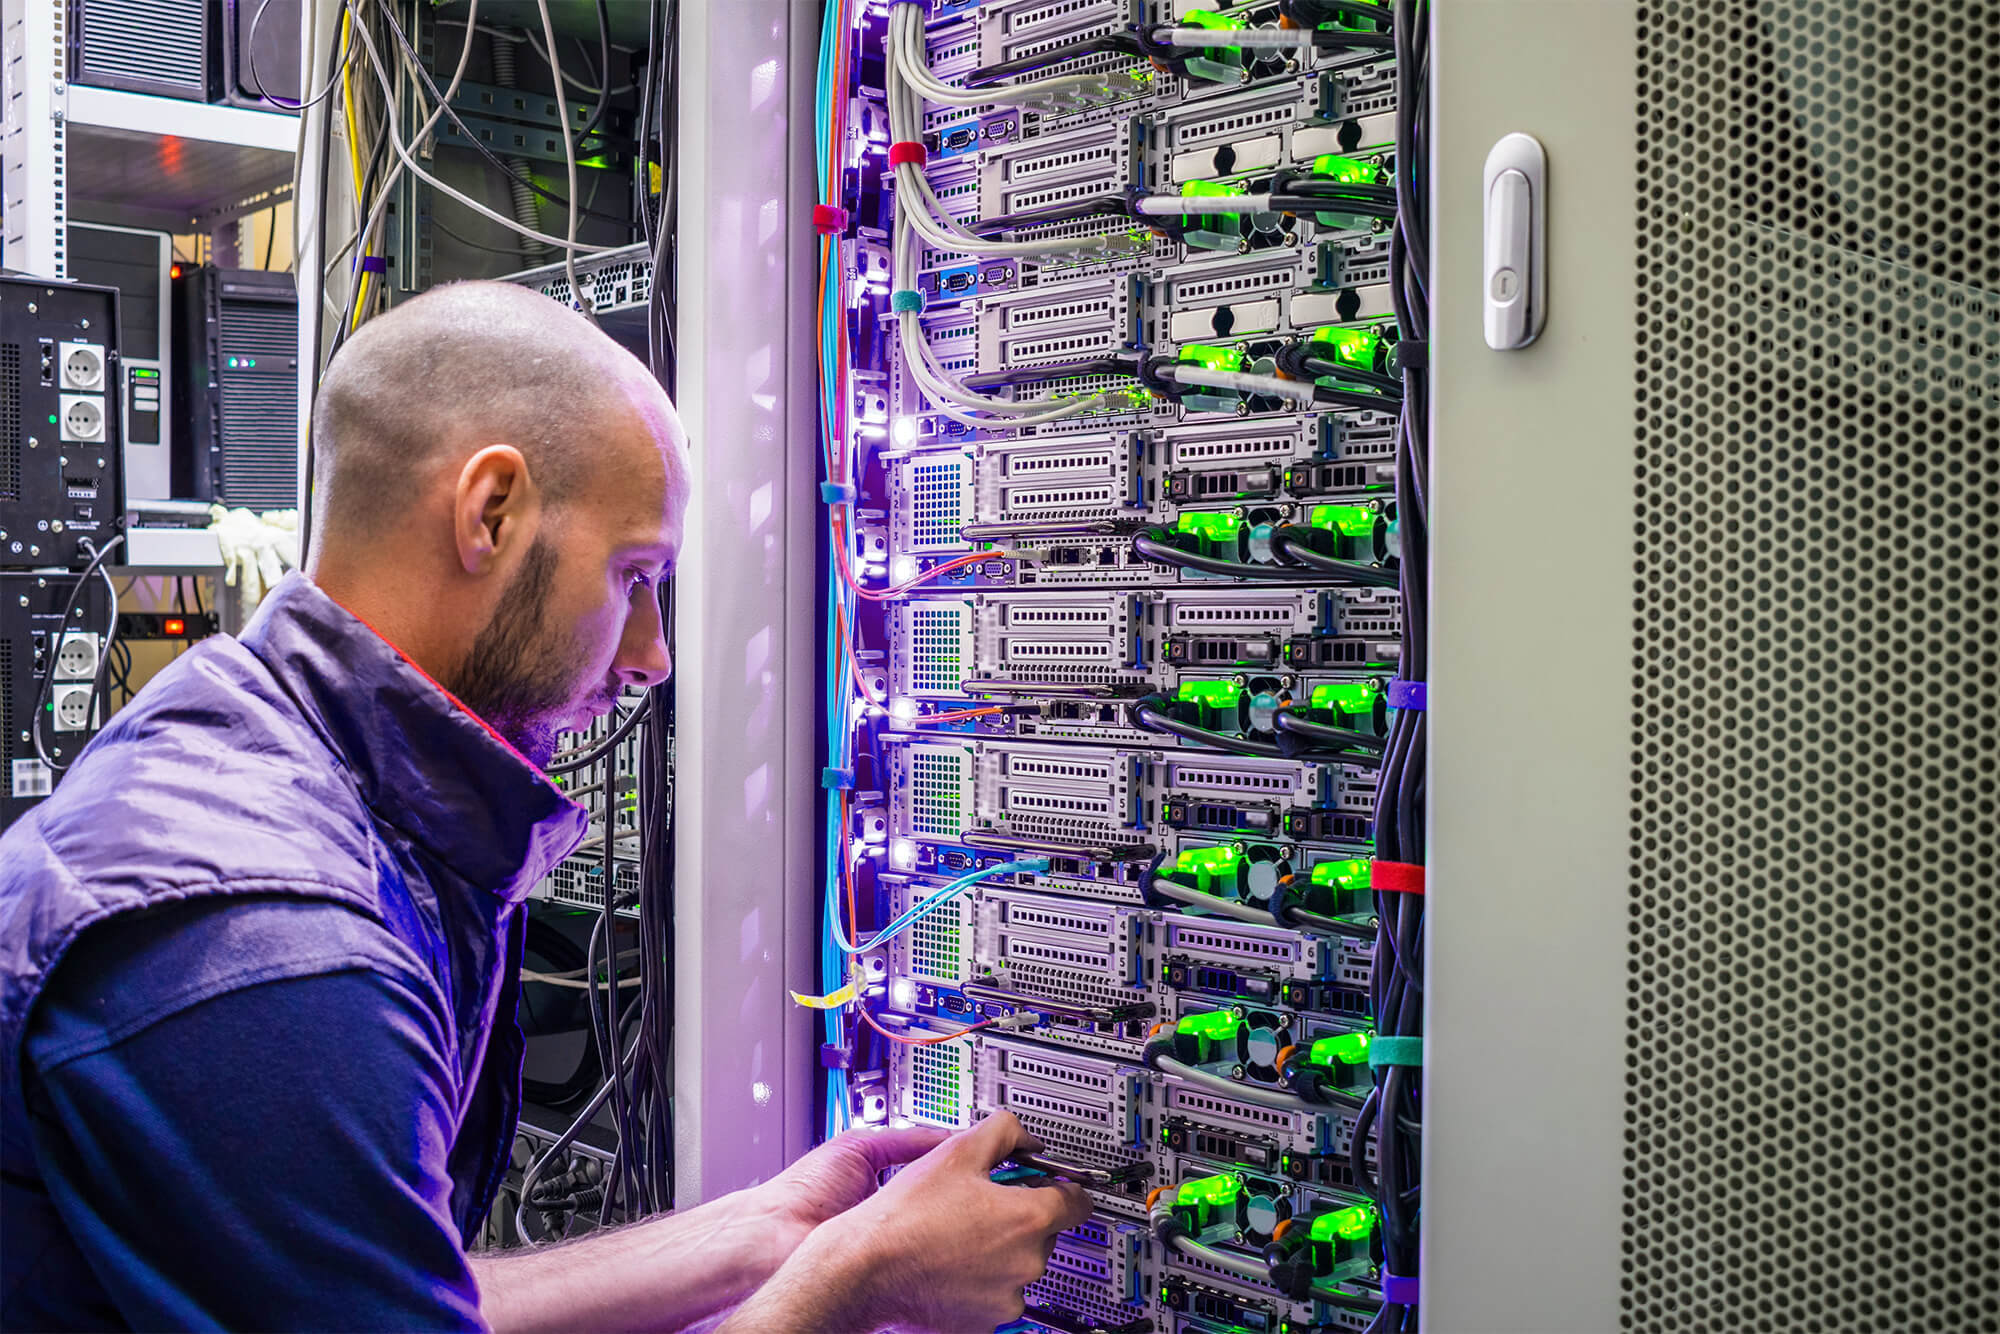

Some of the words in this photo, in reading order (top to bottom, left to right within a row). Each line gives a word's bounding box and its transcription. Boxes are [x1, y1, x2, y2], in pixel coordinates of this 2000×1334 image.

[1310, 82, 1317, 94] 6
[1121, 124, 1128, 133] 4
[1121, 161, 1128, 171] 5
[1309, 251, 1316, 263] 6
[1120, 281, 1126, 292] 4
[1120, 318, 1126, 328] 5
[1309, 423, 1316, 435] 6
[1120, 440, 1127, 450] 4
[1120, 477, 1127, 487] 5
[1119, 601, 1126, 611] 4
[1308, 598, 1316, 610] 6
[1119, 638, 1126, 648] 5
[1119, 762, 1126, 773] 4
[1308, 773, 1315, 784] 6
[1119, 798, 1125, 809] 5
[1120, 920, 1126, 931] 4
[1307, 946, 1315, 958] 6
[1119, 957, 1125, 968] 5
[1118, 1081, 1125, 1091] 4
[1118, 1117, 1124, 1127] 5
[1307, 1120, 1314, 1132] 6
[1117, 1238, 1123, 1249] 4
[1117, 1274, 1123, 1285] 5
